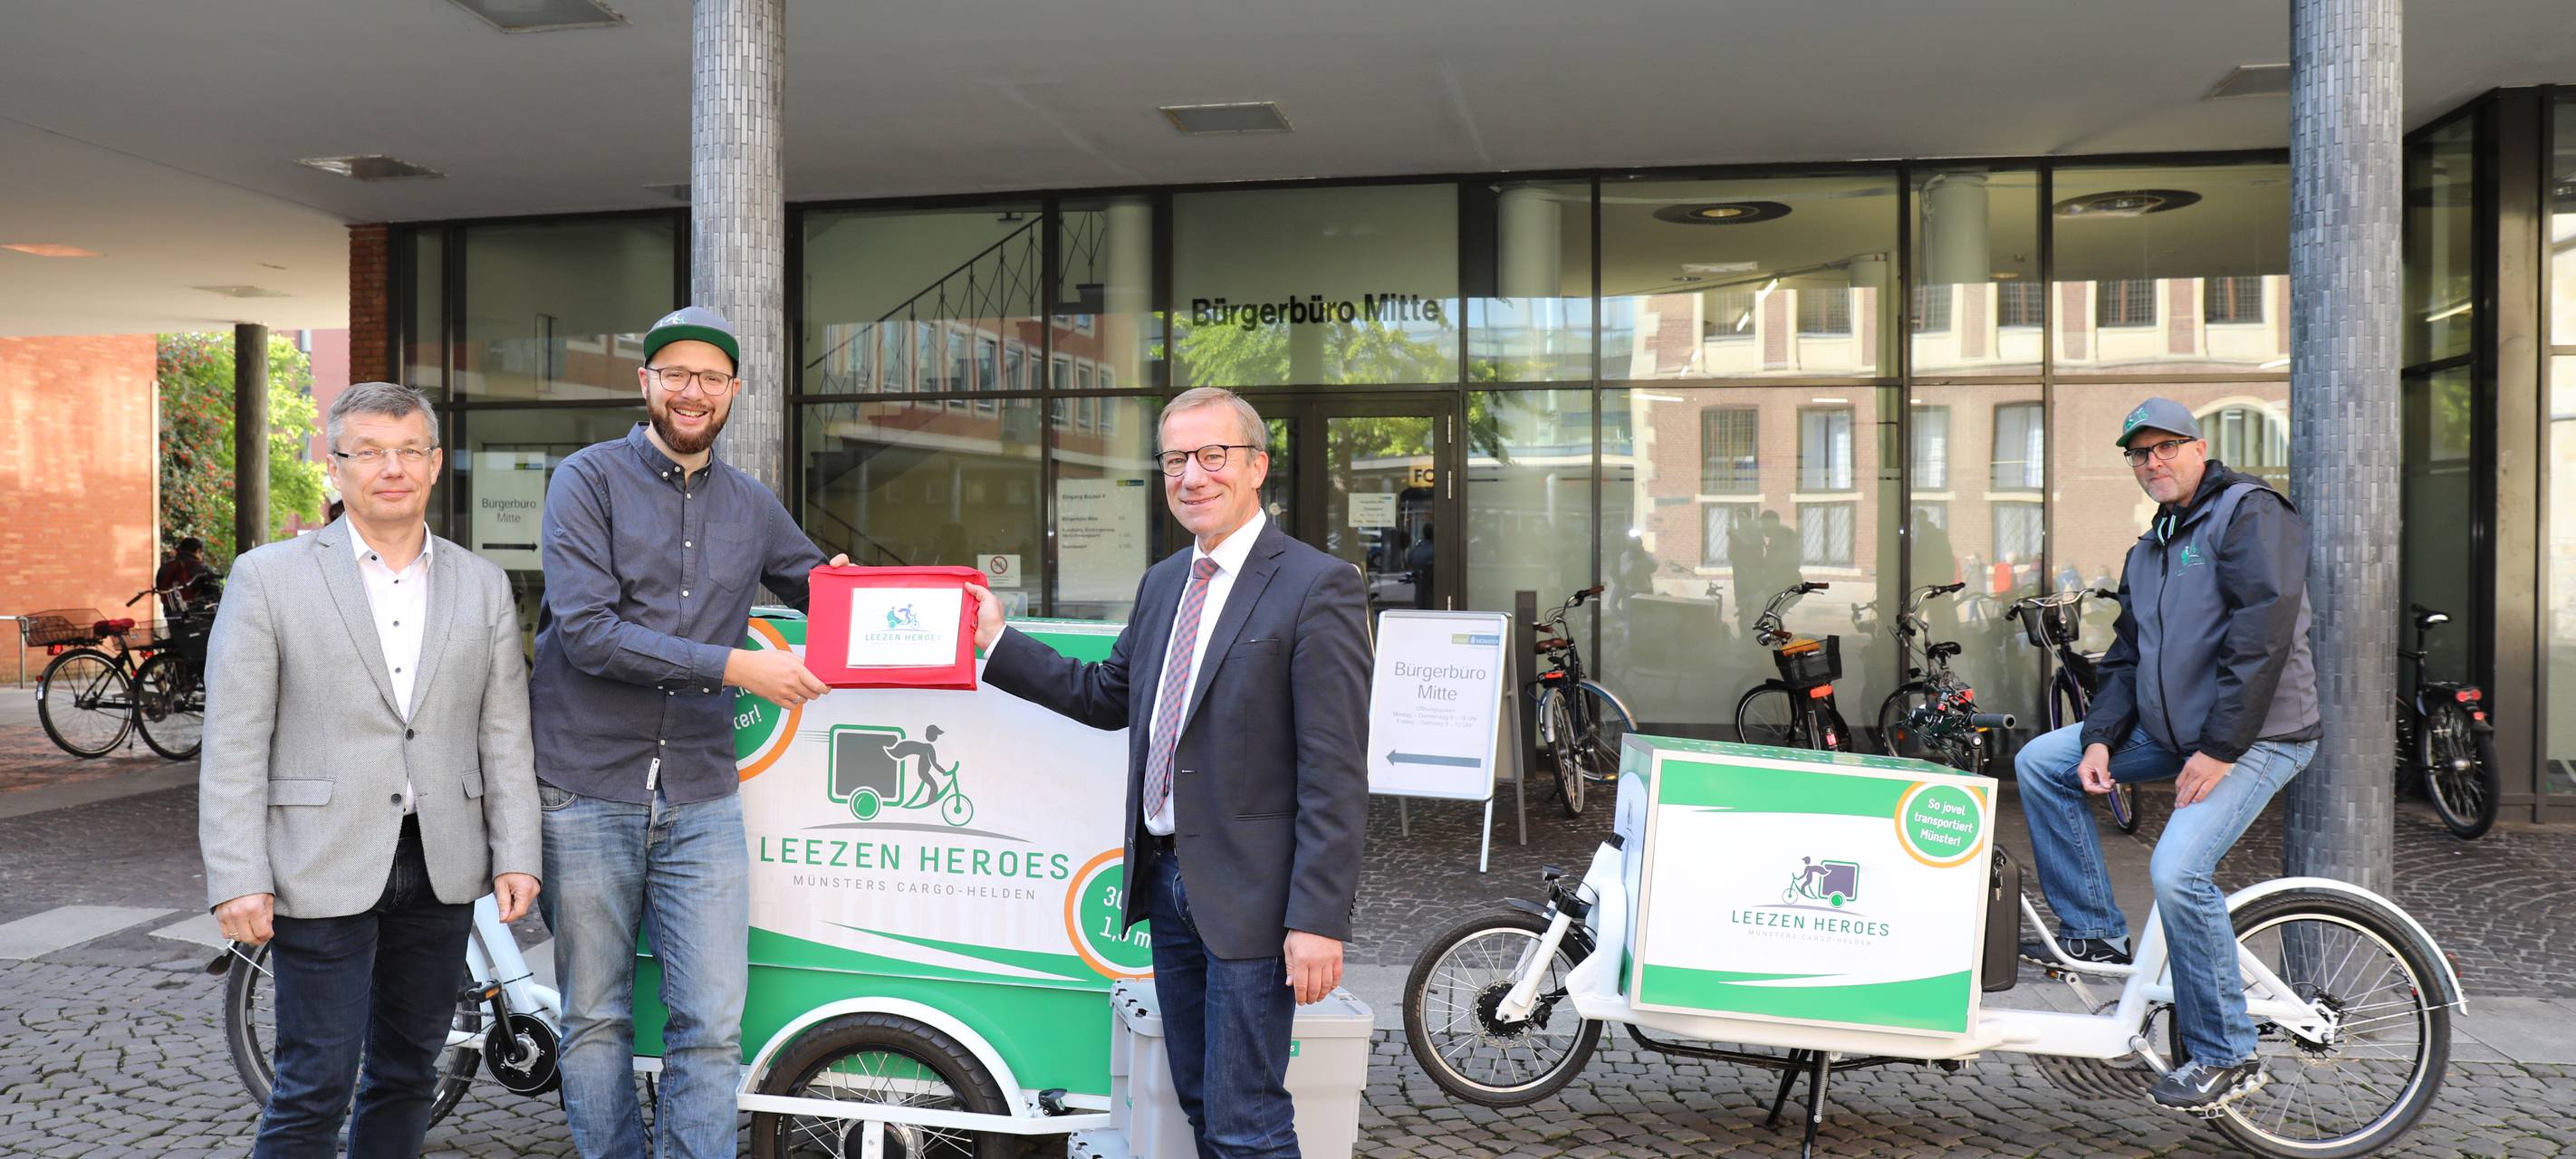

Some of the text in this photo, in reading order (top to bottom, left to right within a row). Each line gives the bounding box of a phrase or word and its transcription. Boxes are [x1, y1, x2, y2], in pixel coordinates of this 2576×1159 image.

[1191, 293, 1440, 331] Bürgerbüro Mitte
[482, 497, 536, 512] Bürgerbüro
[496, 512, 522, 523] Mitte
[864, 633, 901, 642] LEEZEN
[1394, 661, 1486, 683] Bürgerbüro
[1418, 685, 1457, 701] Mitte
[1927, 798, 1966, 816] So jovel
[1914, 811, 1973, 833] transportiert
[1920, 828, 1961, 847] Münster!
[760, 836, 1070, 880] LEEZEN HEROES
[793, 874, 1035, 900] MÜNSTERS CARGO-HELDEN
[1732, 909, 1889, 937] LEEZEN HEROES
